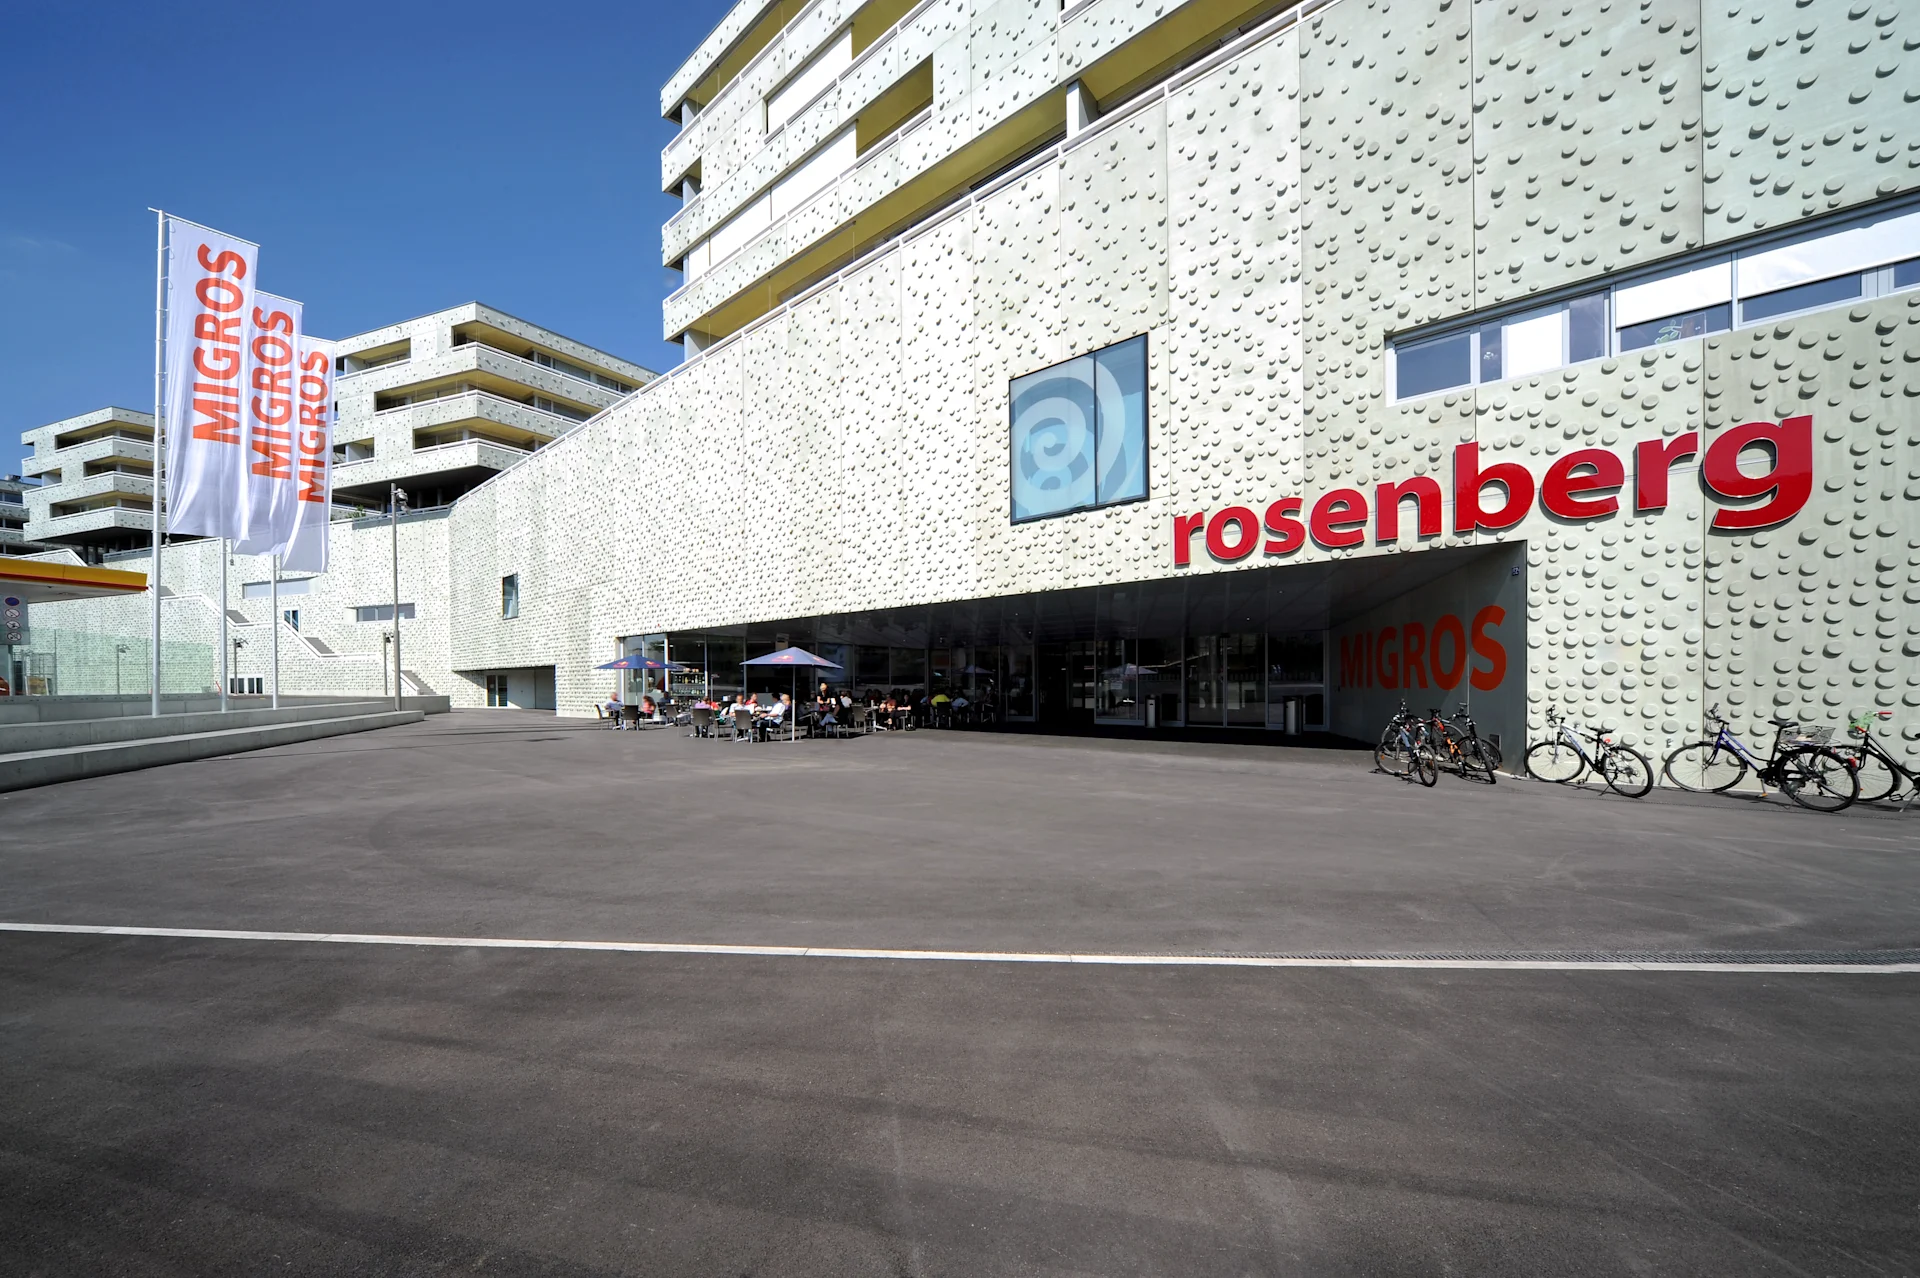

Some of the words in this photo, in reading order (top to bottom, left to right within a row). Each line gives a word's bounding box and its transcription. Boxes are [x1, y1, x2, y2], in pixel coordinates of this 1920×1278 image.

[193, 243, 247, 445] MIGROS
[251, 306, 294, 480] MIGROS
[297, 350, 329, 504] MIGROS
[1174, 414, 1813, 568] rosenberg
[1340, 605, 1507, 691] MIGROS
